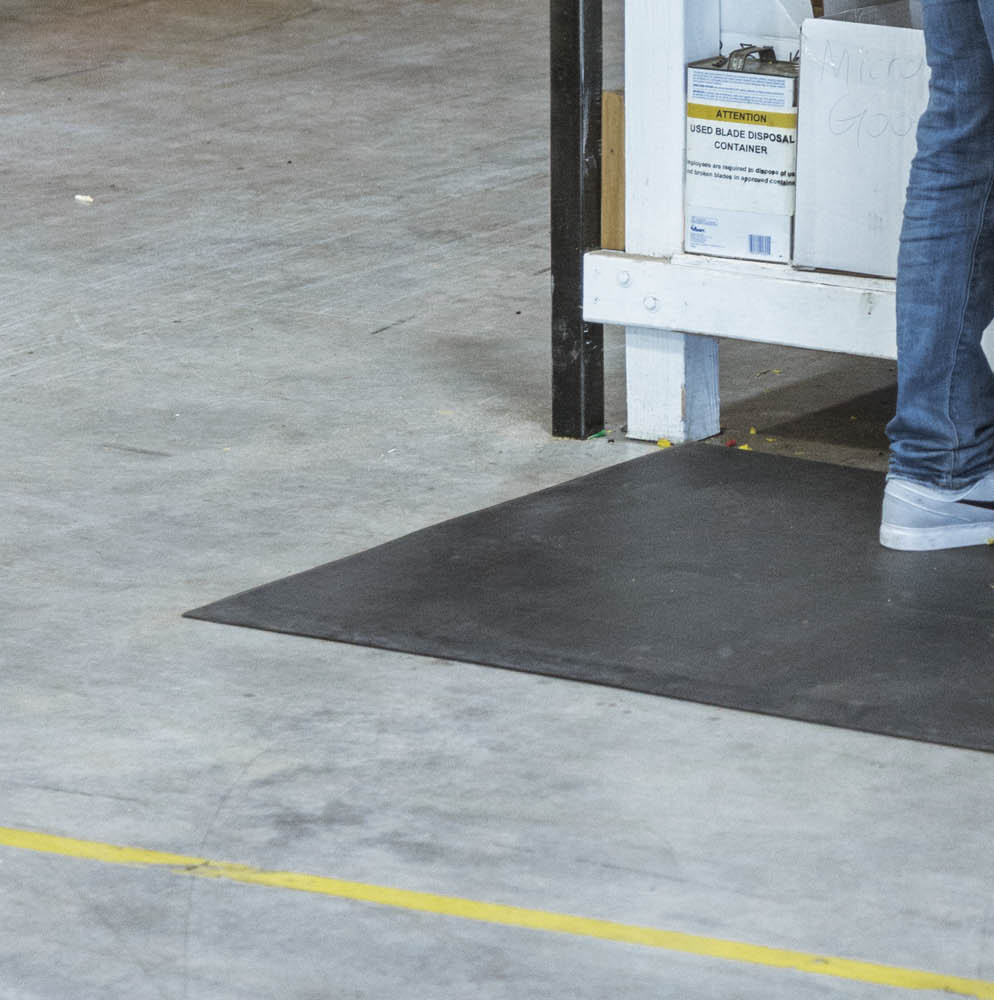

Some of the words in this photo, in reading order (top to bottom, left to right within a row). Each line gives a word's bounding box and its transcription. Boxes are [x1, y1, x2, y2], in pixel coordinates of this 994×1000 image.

[716, 110, 767, 122] ATTENTION
[690, 124, 713, 134] USED
[715, 127, 745, 139] BLADE
[748, 130, 795, 144] DISPOSAL
[714, 141, 768, 154] CONTAINER
